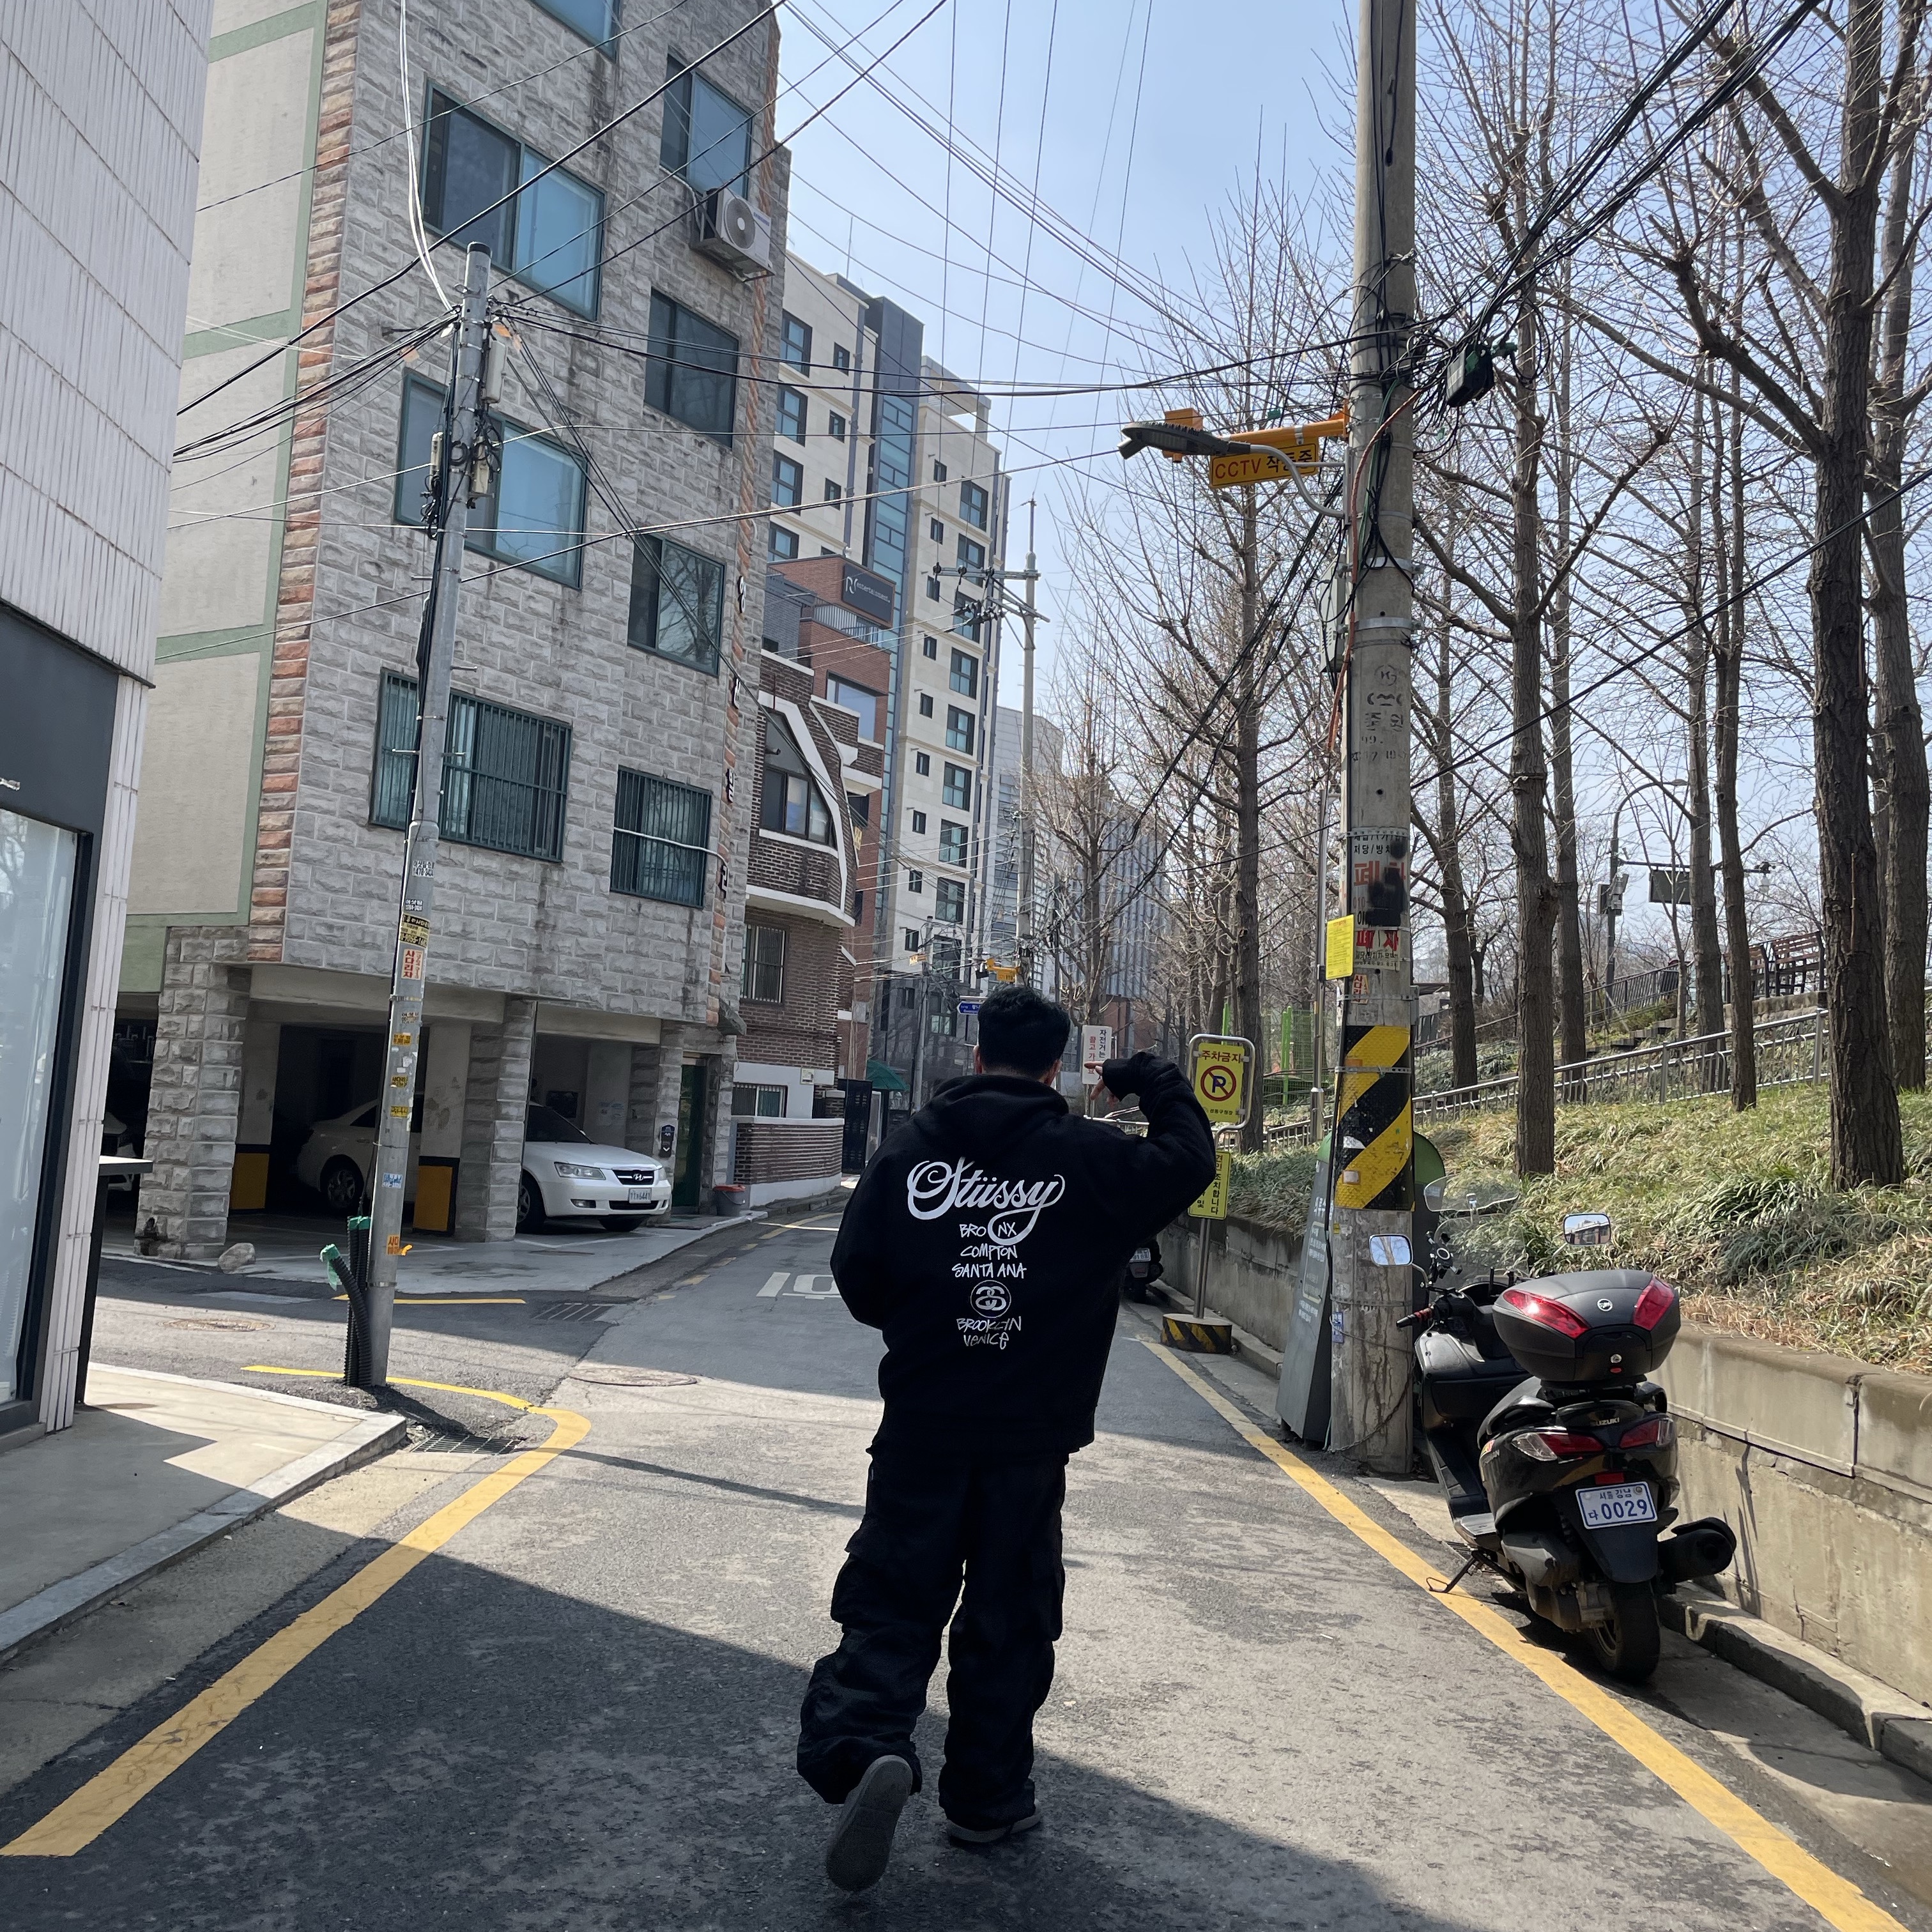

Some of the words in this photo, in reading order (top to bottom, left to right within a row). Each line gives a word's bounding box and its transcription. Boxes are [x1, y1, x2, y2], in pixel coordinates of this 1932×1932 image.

[1215, 458, 1261, 479] CCTV
[1099, 1029, 1107, 1058] 자전거는
[1202, 1050, 1241, 1063] 주차금지
[960, 1243, 1018, 1261] COMPTON
[952, 1262, 993, 1278] SANTA
[997, 1262, 1027, 1279] ANA
[956, 1316, 1022, 1333] BROOKLYN
[1599, 1492, 1613, 1500] 서울
[1615, 1488, 1632, 1499] 강남
[1588, 1509, 1598, 1521] 다
[1600, 1499, 1648, 1520] 0029
